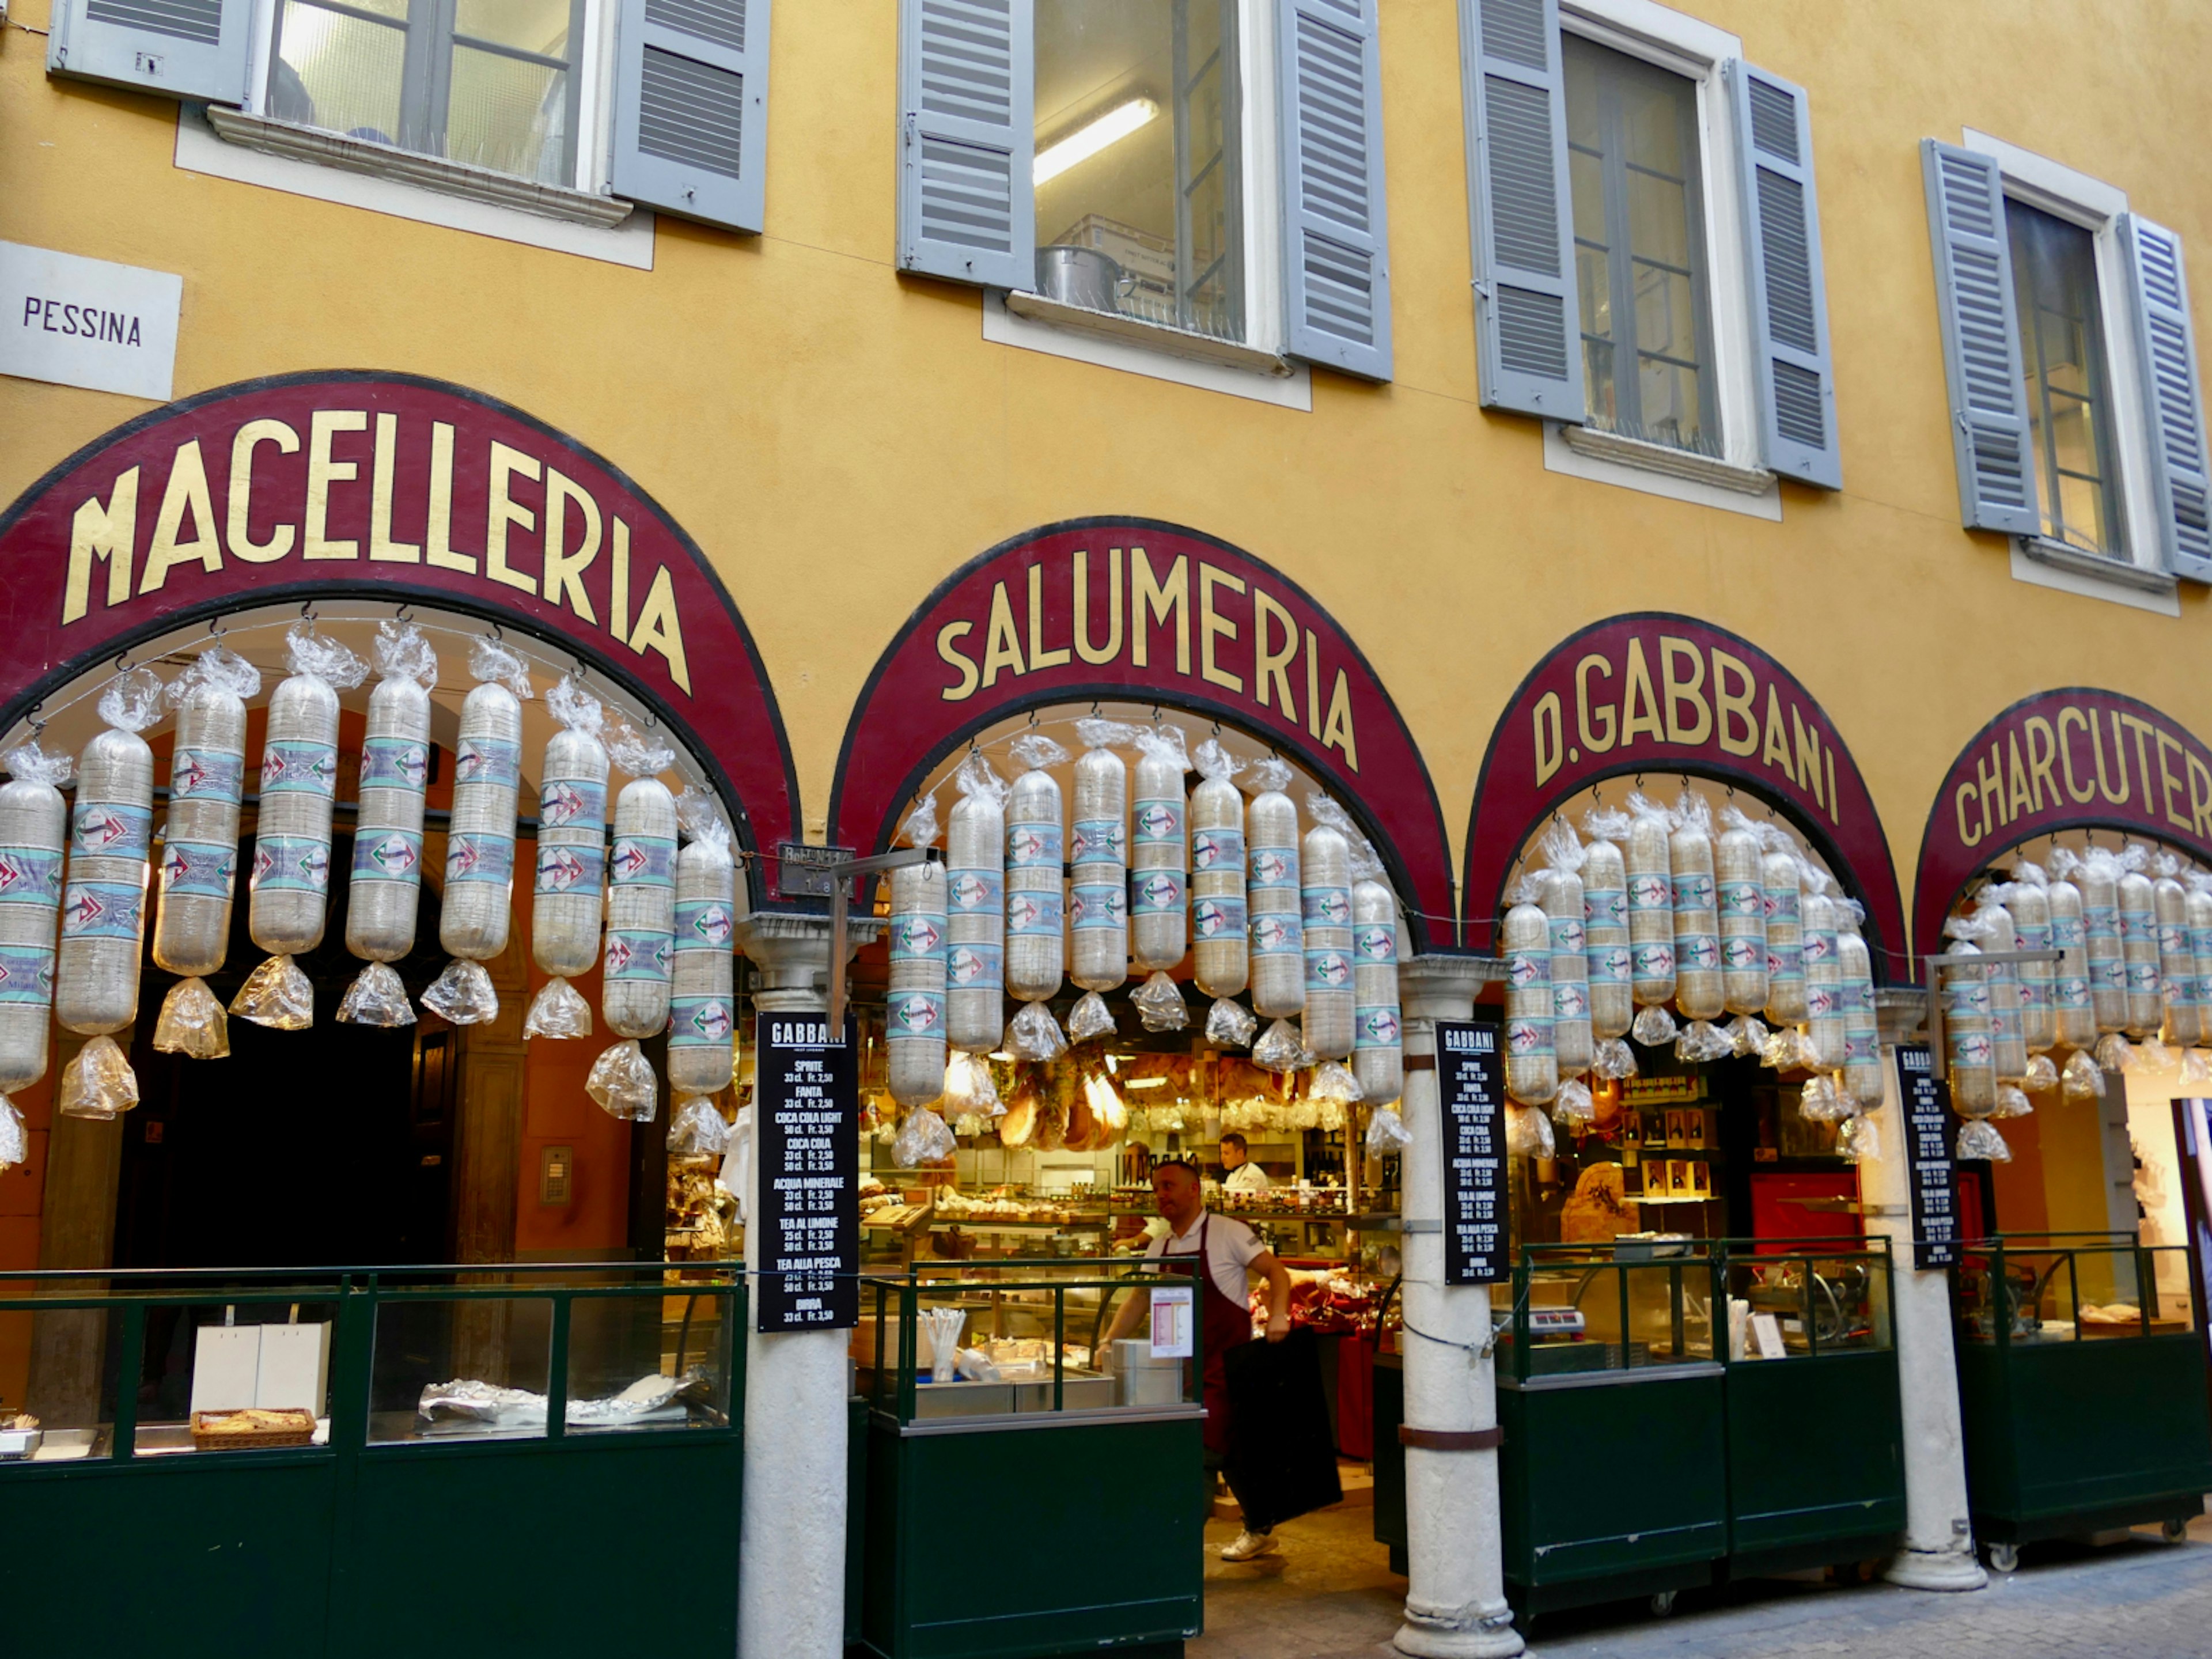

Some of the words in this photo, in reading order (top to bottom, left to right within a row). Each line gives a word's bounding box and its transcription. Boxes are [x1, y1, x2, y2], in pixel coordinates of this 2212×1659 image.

[24, 296, 140, 347] PESSINA
[62, 410, 692, 699] MACELLERIA
[936, 546, 1360, 775] SALUMERIA
[1956, 706, 2212, 847] CHARCUTER
[772, 1022, 846, 1044] GABBAI
[1445, 1030, 1494, 1049] GABBANI
[795, 1060, 823, 1072] SPRITE
[796, 1086, 823, 1097] FANTA
[775, 1112, 798, 1123] COCA
[799, 1112, 819, 1123] COLA
[821, 1112, 842, 1123] LIGHT
[787, 1138, 809, 1149] COCA
[810, 1138, 831, 1149] COLA
[774, 1178, 802, 1190] ACQUA
[804, 1177, 844, 1189] MINERALE
[779, 1218, 795, 1229] TEA
[796, 1218, 806, 1229] AL
[808, 1217, 838, 1229] LIMONE
[777, 1259, 792, 1270] TEA
[793, 1258, 813, 1270] ALLA
[814, 1256, 841, 1268] PESCA
